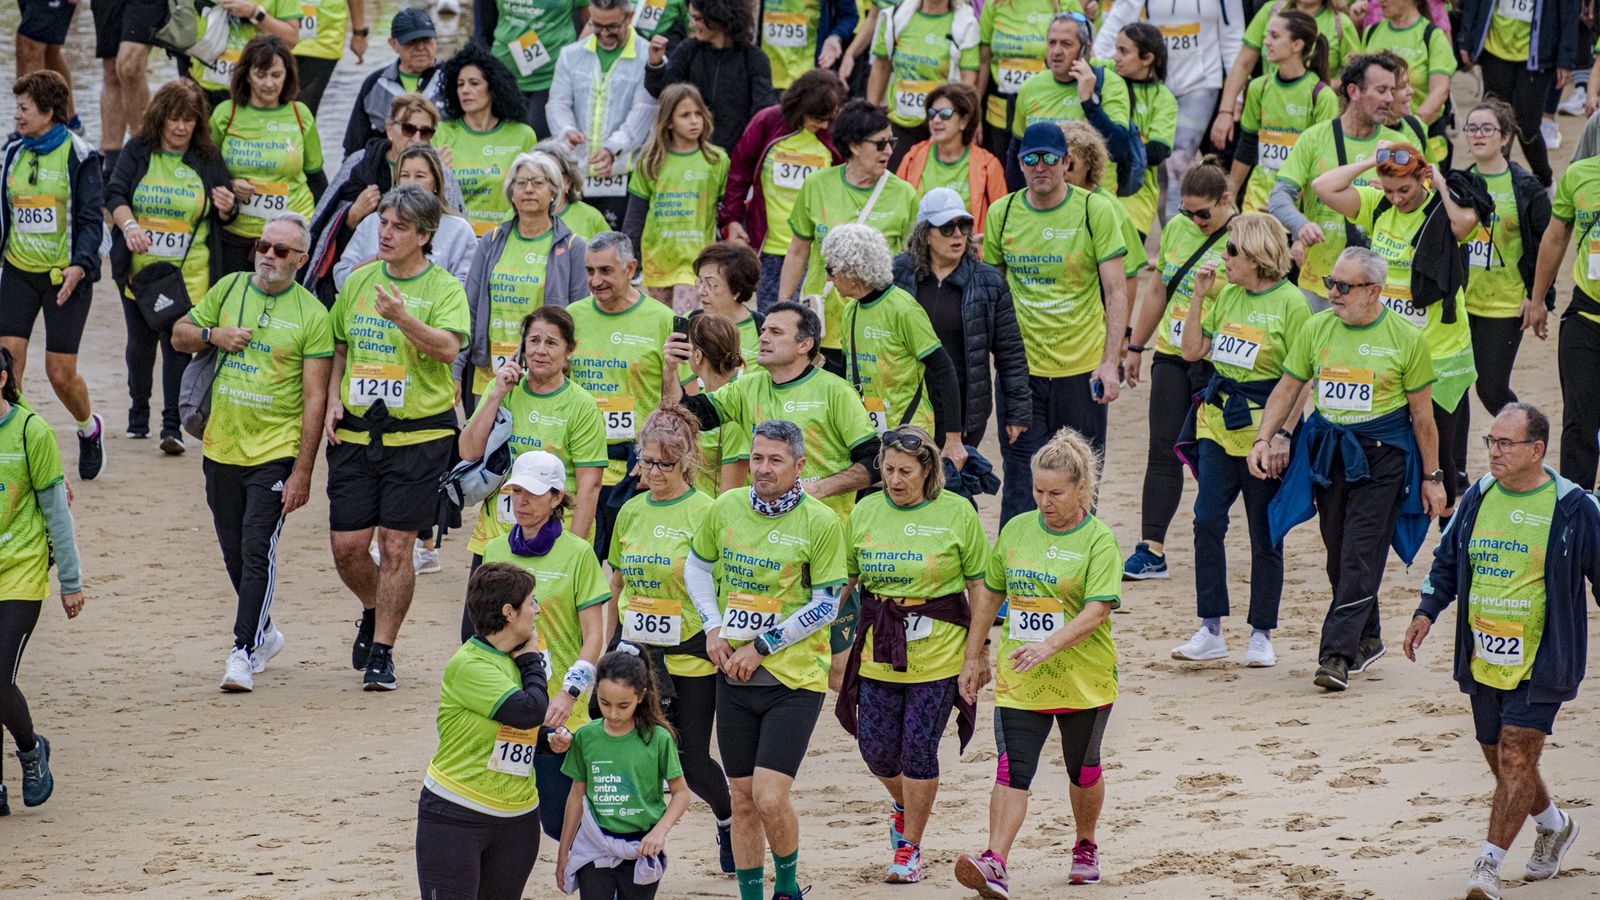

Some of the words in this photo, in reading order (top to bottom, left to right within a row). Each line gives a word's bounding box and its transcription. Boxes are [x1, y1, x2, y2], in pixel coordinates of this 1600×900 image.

[768, 24, 804, 38] 3795
[523, 43, 544, 62] 92
[1263, 143, 1293, 160] 230
[17, 207, 54, 224] 2863
[1019, 254, 1063, 264] marcha
[1009, 265, 1040, 275] ontra
[499, 272, 539, 284] marcha
[493, 293, 529, 305] cáncer
[357, 340, 398, 354] cáncer
[1218, 335, 1258, 358] 2077
[583, 357, 628, 369] marcha
[356, 378, 403, 398] 1216
[1324, 381, 1371, 401] 2078
[509, 433, 542, 448] archa
[1478, 538, 1529, 553] marcha
[625, 552, 671, 566] marcha
[723, 547, 734, 560] En
[735, 552, 781, 571] marcha
[861, 548, 872, 560] En
[875, 549, 924, 562] marcha
[861, 562, 896, 573] contra
[730, 575, 771, 592] cáncer
[871, 573, 915, 585] cáncer
[1015, 567, 1058, 585] marcha
[633, 613, 672, 634] 365
[726, 608, 776, 631] 2994
[1019, 611, 1055, 632] 366
[1478, 631, 1520, 655] 1222
[599, 793, 630, 803] cáncer
